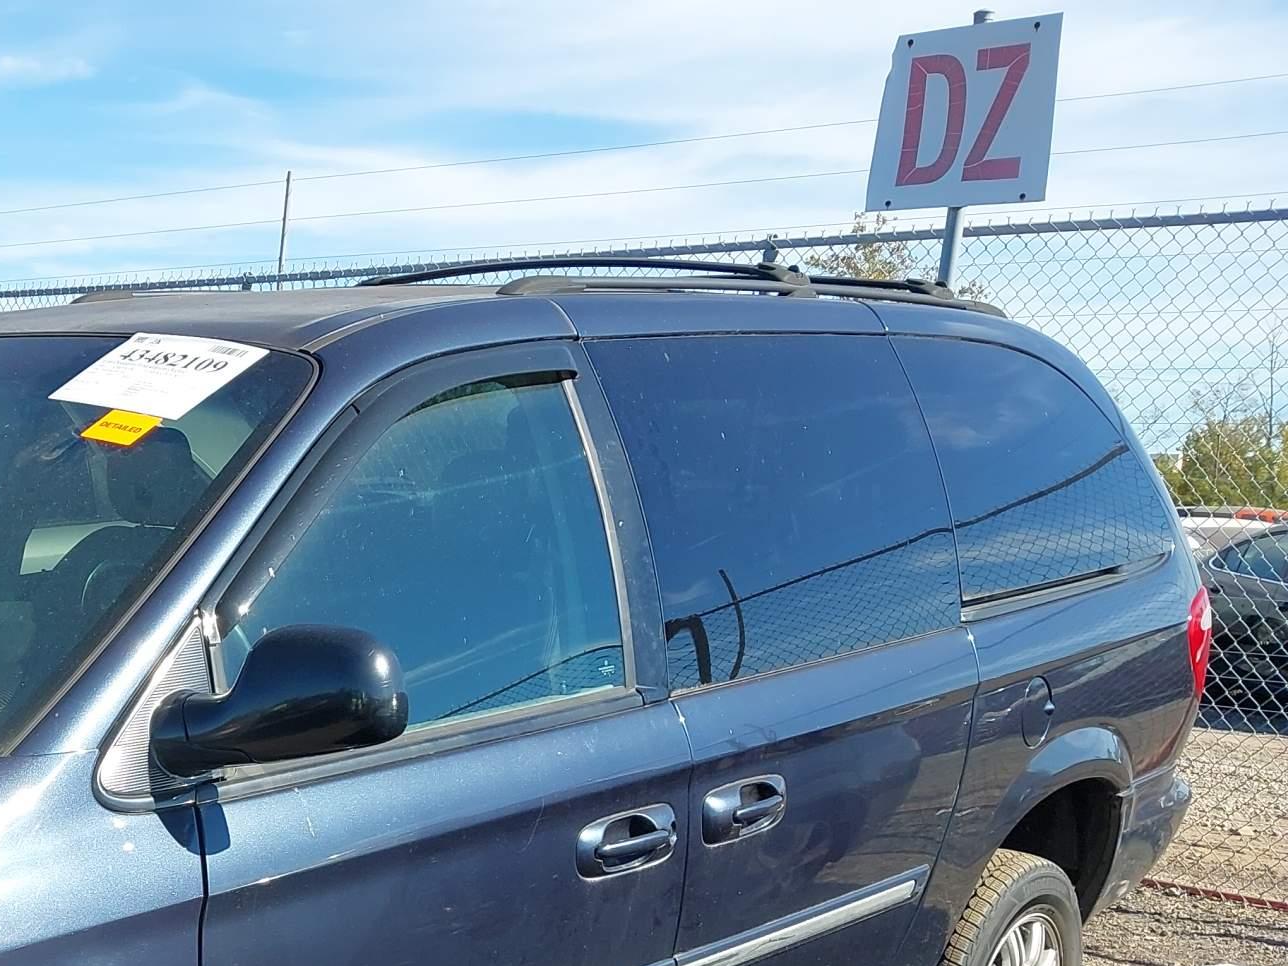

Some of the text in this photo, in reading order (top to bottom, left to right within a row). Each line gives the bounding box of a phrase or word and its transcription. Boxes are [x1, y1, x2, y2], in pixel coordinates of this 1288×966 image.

[895, 42, 1032, 188] DZ
[119, 348, 229, 373] 43482109
[99, 421, 143, 434] DETAILED
